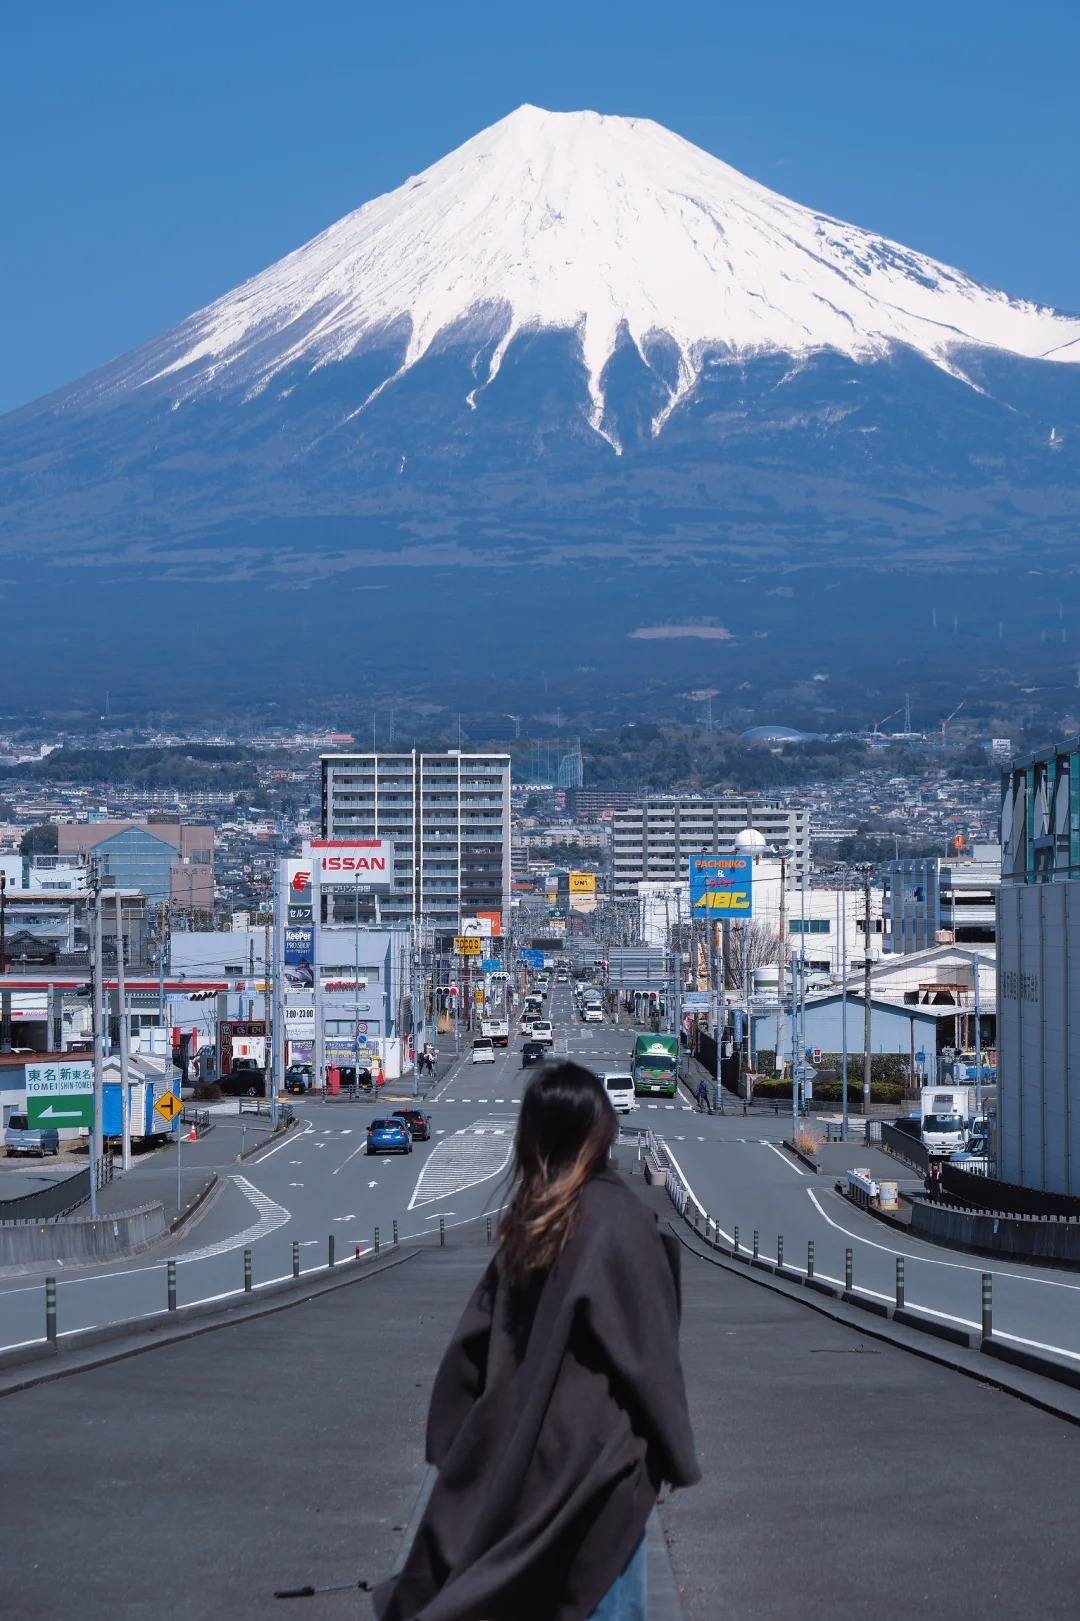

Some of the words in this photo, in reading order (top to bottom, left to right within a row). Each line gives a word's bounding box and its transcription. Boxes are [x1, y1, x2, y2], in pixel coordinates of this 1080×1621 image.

[322, 858, 385, 871] ISSAN
[695, 860, 746, 868] PACHINKO
[717, 869, 725, 878] &
[693, 891, 750, 909] ABC
[289, 908, 311, 918] セルフ
[286, 931, 312, 941] KeePer
[27, 1068, 56, 1082] 東名
[60, 1067, 91, 1081] 新東名
[27, 1082, 58, 1091] TOMEI
[60, 1081, 92, 1090] SHIN-TOMEI
